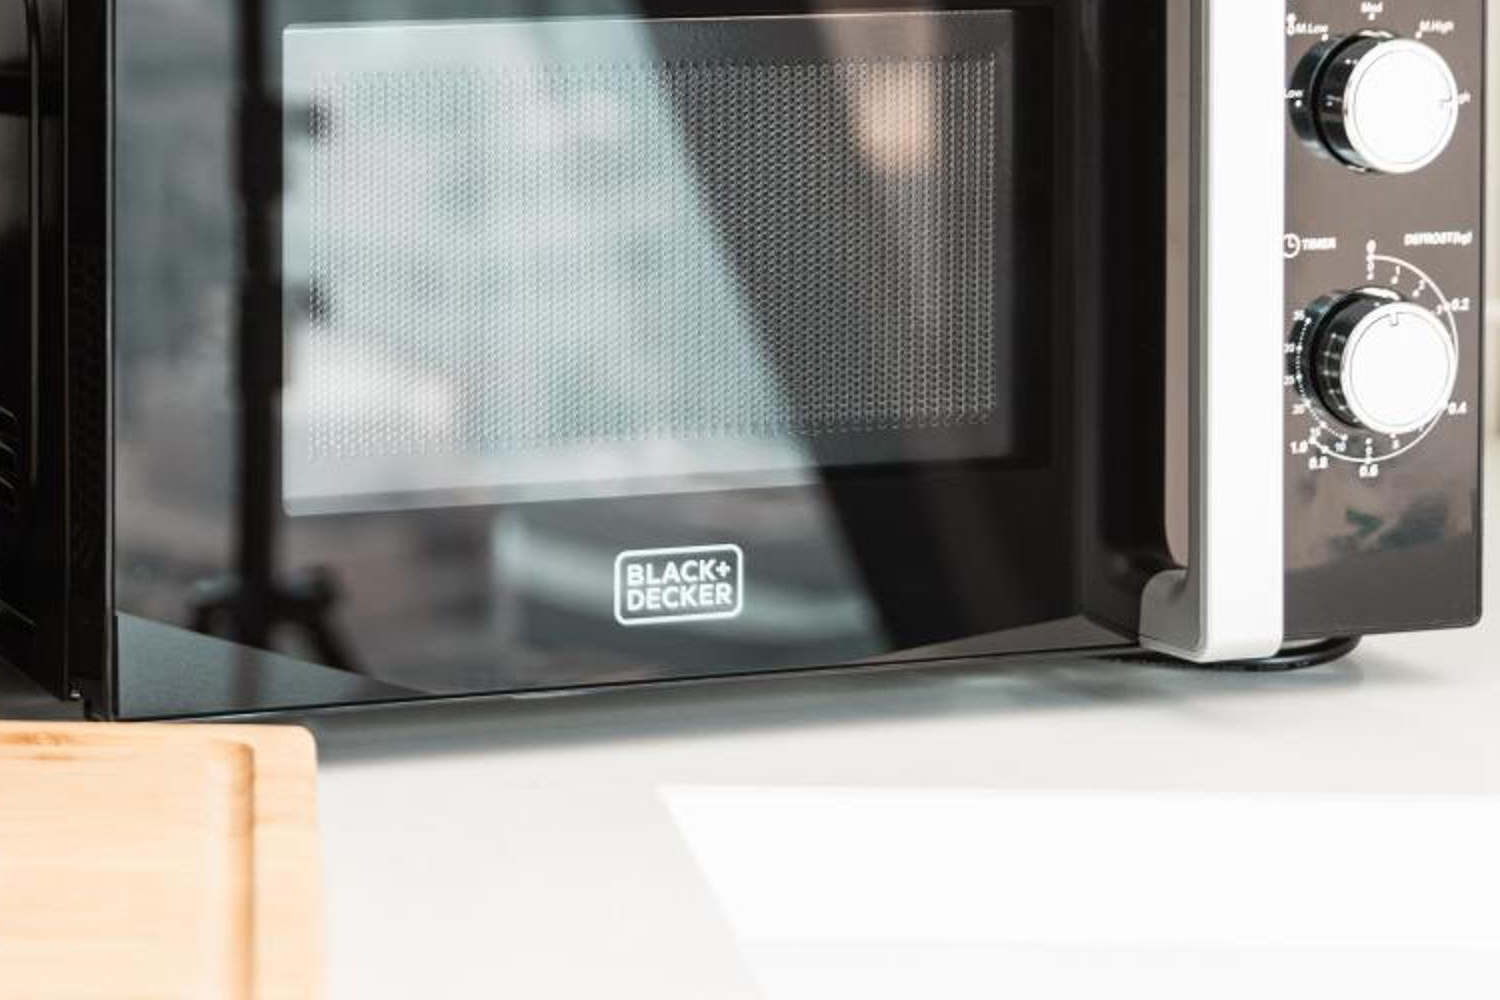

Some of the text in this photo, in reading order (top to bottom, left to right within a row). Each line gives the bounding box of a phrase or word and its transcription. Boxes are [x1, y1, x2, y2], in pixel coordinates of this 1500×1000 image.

[1303, 237, 1337, 250] TIMER
[1451, 298, 1469, 311] 0.2
[1447, 401, 1468, 415] 0.4
[1290, 440, 1309, 455] 1.0
[1359, 464, 1378, 478] 0.6
[626, 558, 731, 587] BLACK+
[626, 582, 733, 612] DECKER
